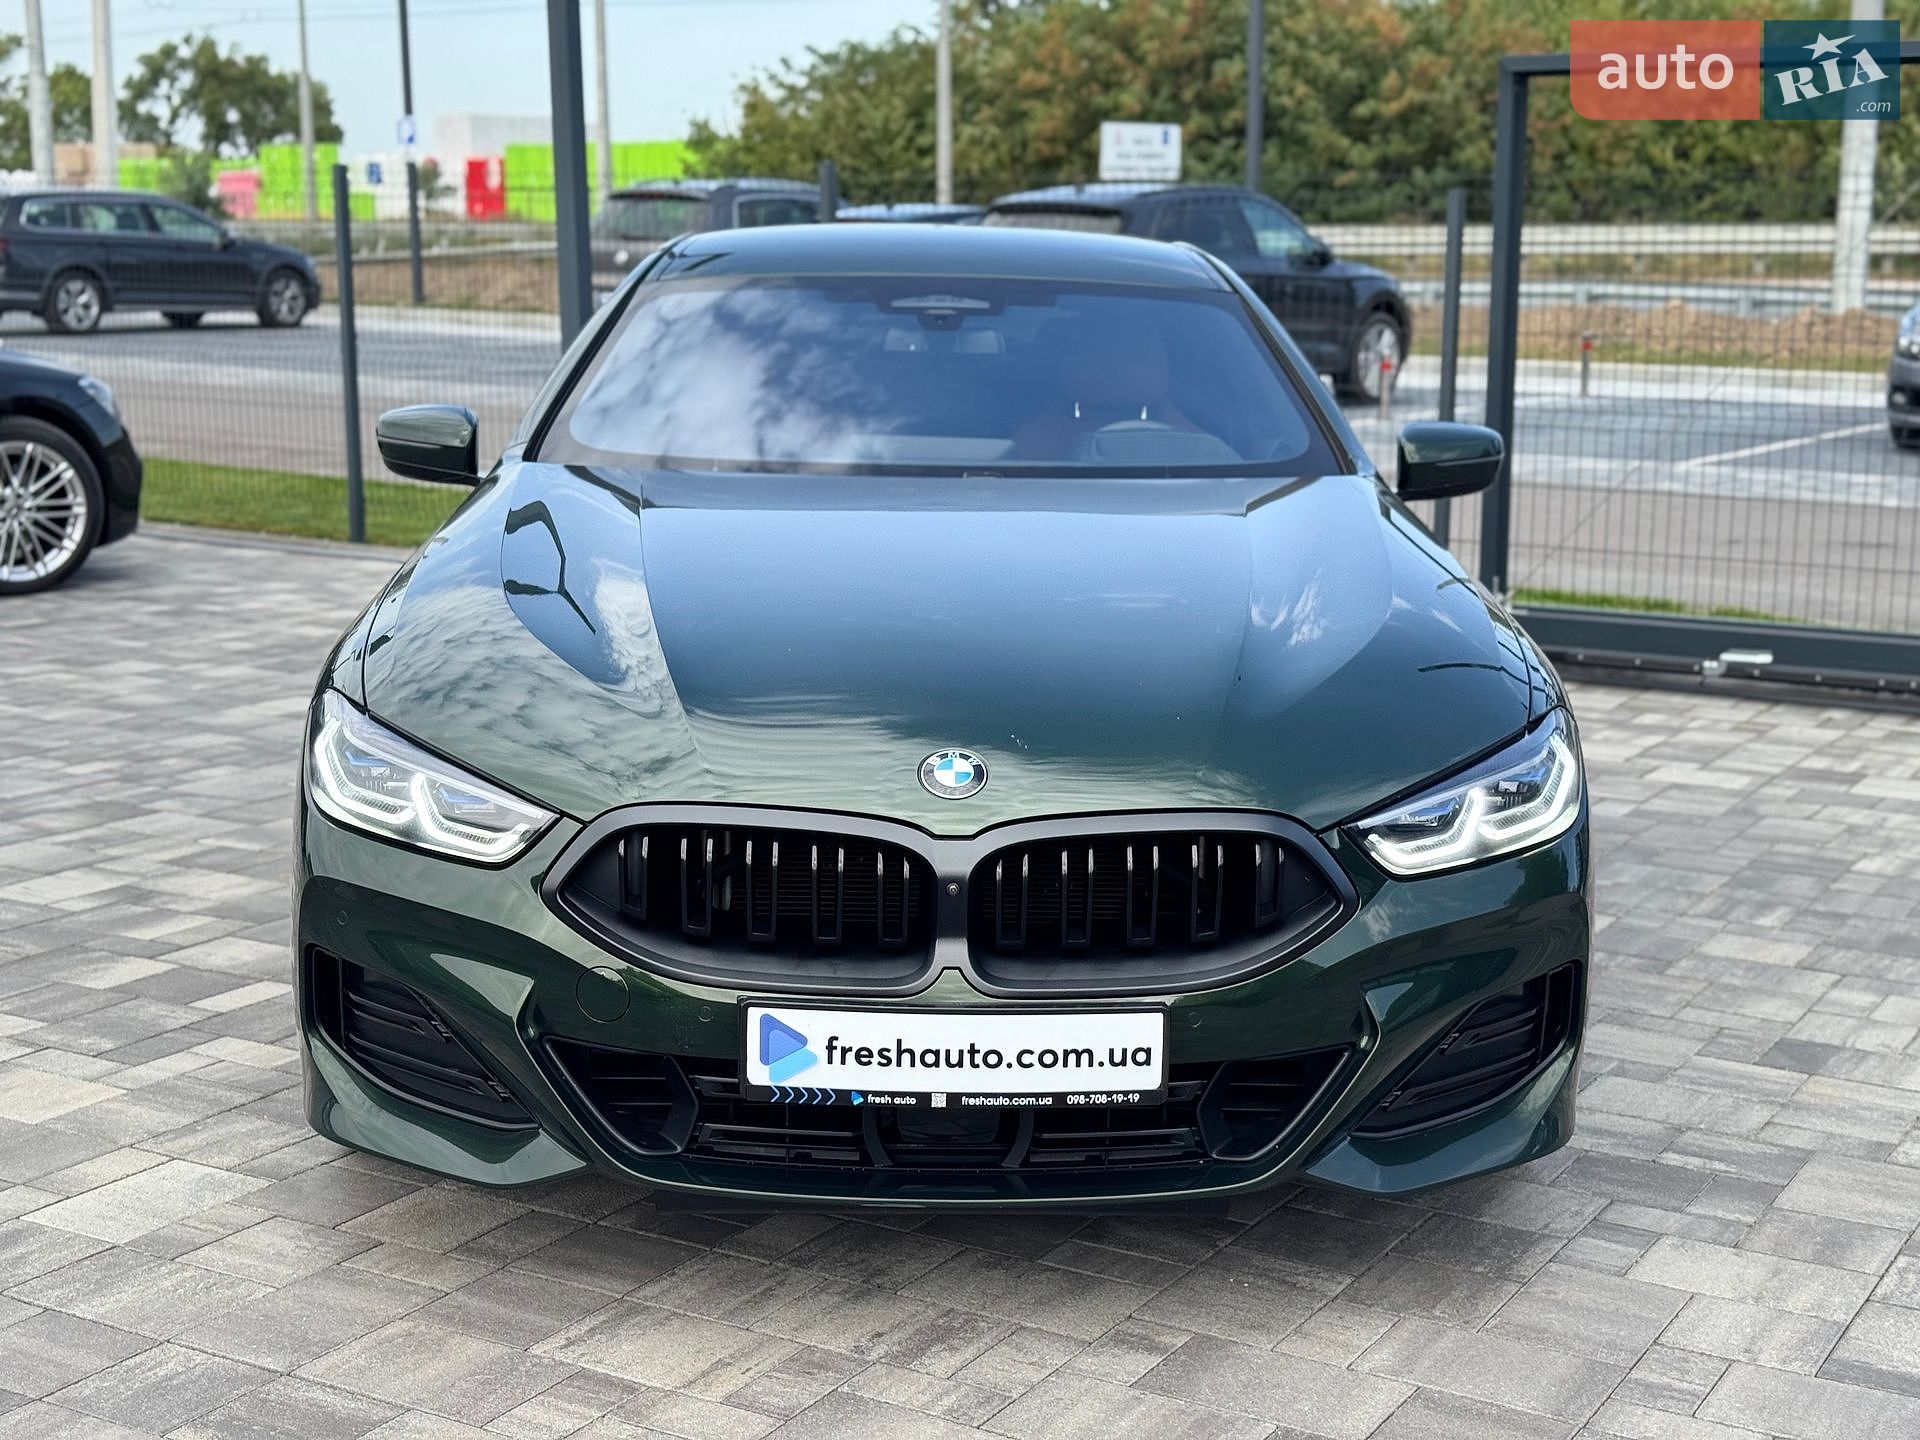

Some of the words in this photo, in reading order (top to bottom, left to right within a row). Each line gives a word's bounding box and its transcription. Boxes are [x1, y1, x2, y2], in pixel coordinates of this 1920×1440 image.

[825, 1035, 1152, 1070] freshauto.com.ua
[867, 1093, 892, 1105] fresh
[893, 1096, 917, 1105] auto
[961, 1095, 1053, 1106] freshauto.com.ua
[1066, 1093, 1140, 1105] 098-708-19-19
